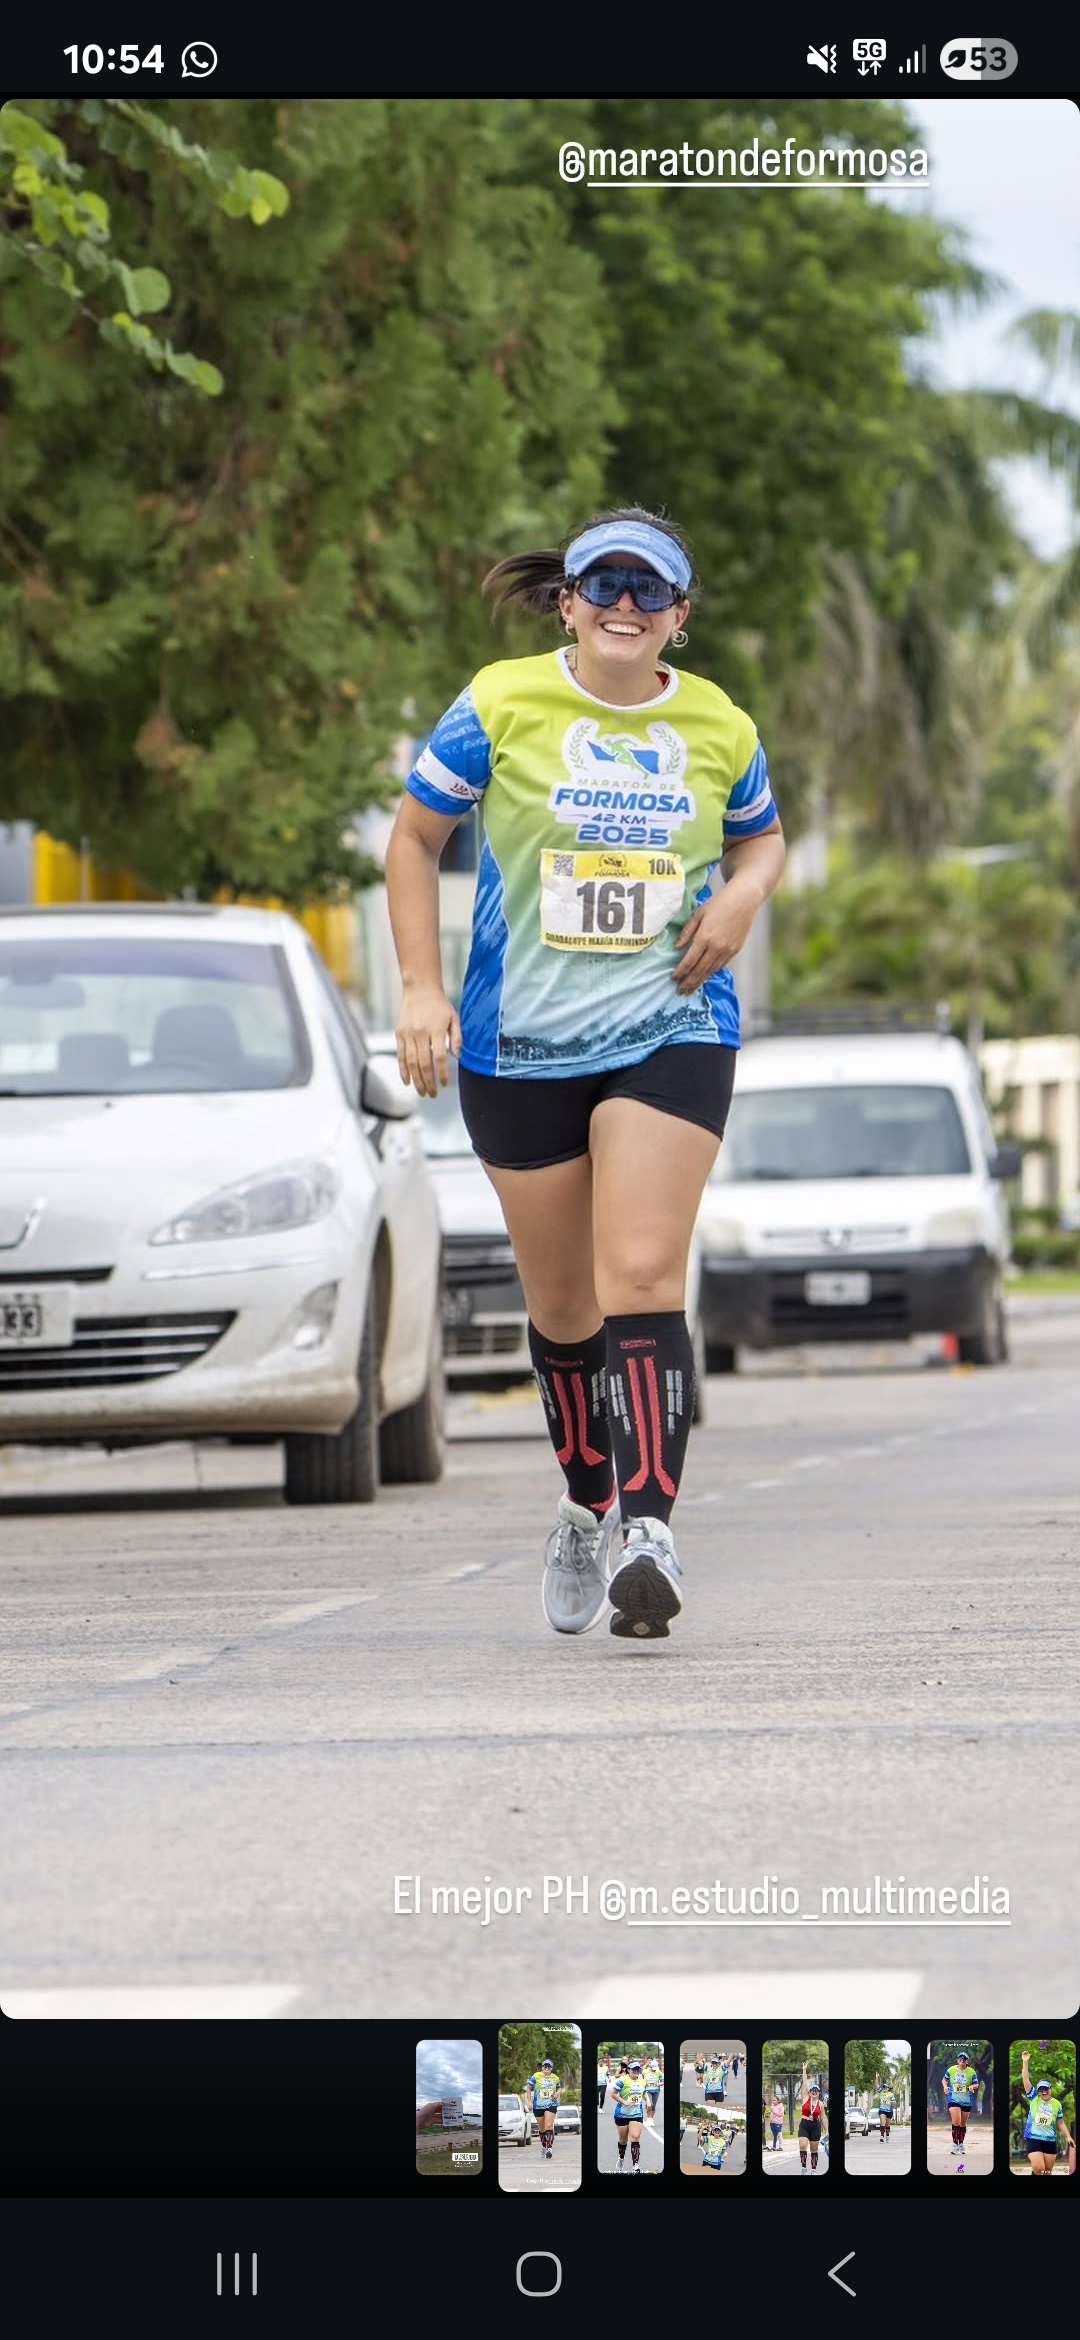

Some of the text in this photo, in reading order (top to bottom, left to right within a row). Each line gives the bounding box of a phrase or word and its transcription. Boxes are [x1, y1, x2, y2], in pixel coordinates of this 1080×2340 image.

[578, 779, 651, 790] MARATON
[555, 788, 690, 814] FORMOSA
[592, 813, 647, 825] 42 KM
[578, 824, 669, 845] 2025
[648, 859, 677, 875] 10K
[576, 881, 645, 935] 161
